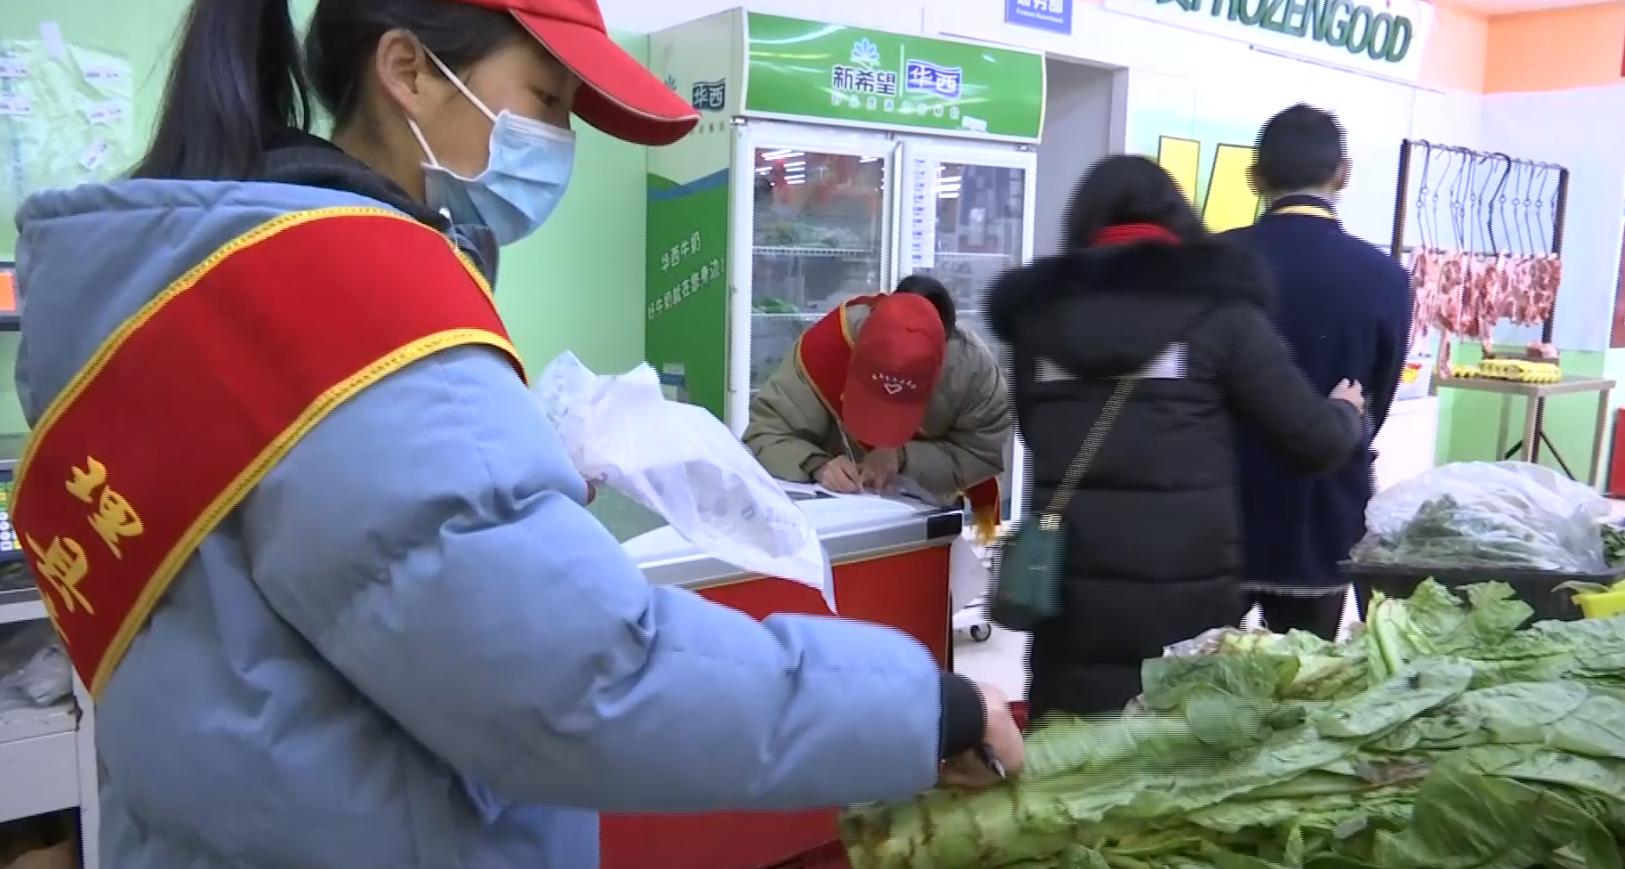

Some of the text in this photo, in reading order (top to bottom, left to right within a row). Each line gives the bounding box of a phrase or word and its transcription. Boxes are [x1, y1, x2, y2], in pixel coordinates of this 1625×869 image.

[833, 65, 897, 96] 新希望
[907, 62, 960, 96] 华西
[693, 83, 724, 108] 华西
[661, 231, 701, 273] 华西牛奶
